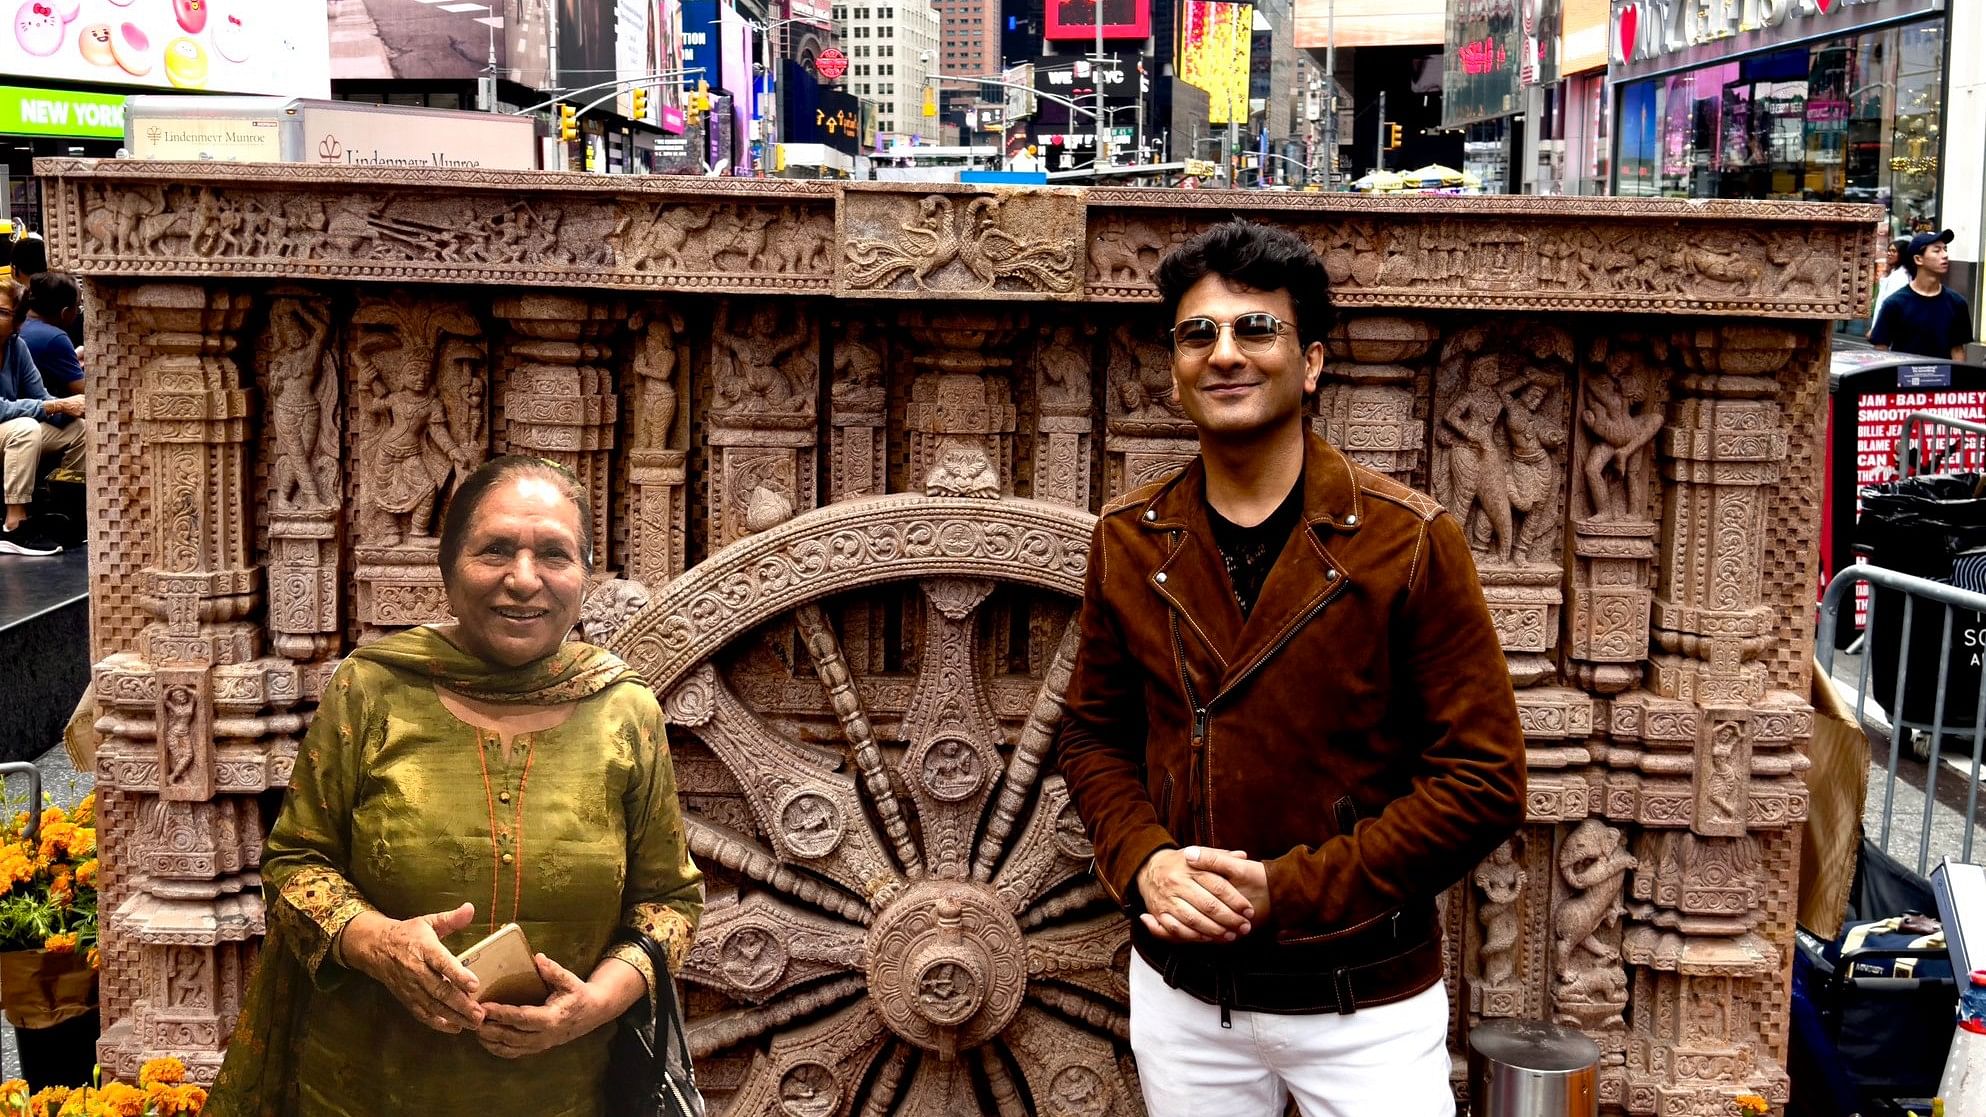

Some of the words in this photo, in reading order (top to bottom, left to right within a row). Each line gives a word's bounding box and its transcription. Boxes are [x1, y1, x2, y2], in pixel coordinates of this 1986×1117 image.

[1048, 71, 1073, 84] WE
[20, 99, 69, 125] NEW
[72, 103, 124, 128] YORK
[225, 132, 265, 143] Munroe
[1858, 395, 1886, 407] JAM
[1896, 394, 1927, 406] BAD
[1934, 392, 1986, 405] MONEY
[1858, 425, 1885, 438] BILLIE
[1886, 425, 1903, 437] JEA
[1857, 440, 1891, 453] BLAME
[1857, 454, 1888, 467] CAN
[1970, 653, 1985, 667] A
